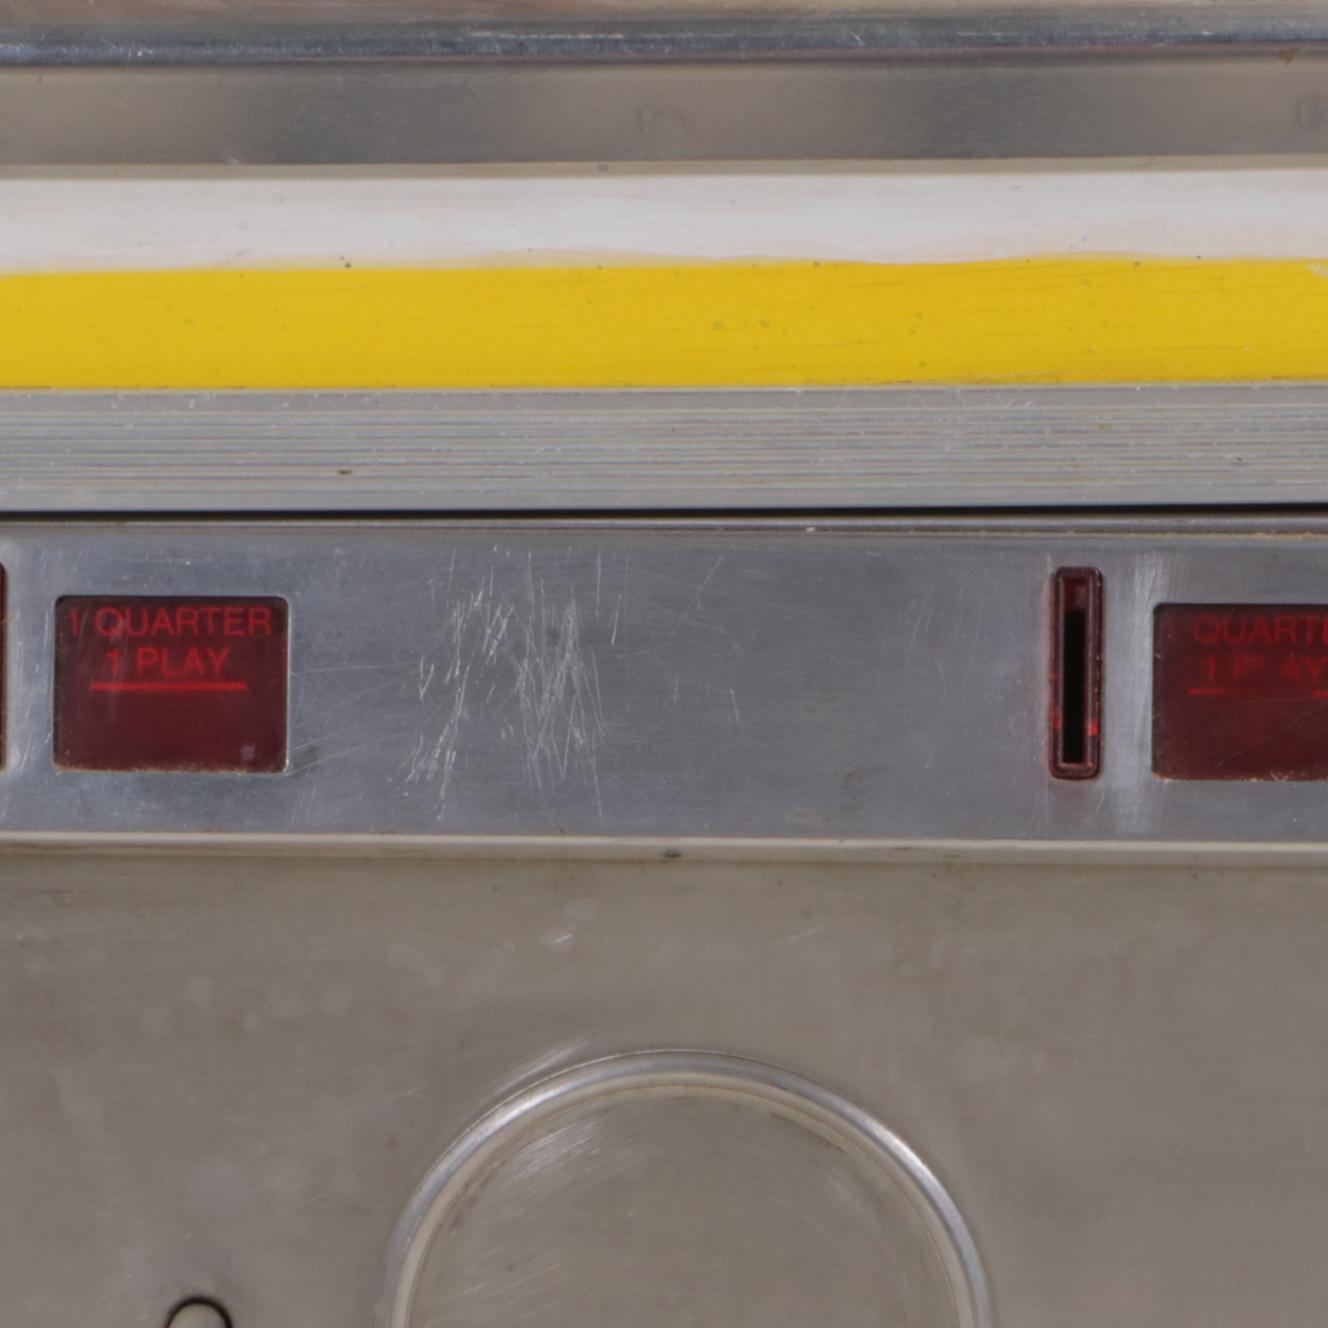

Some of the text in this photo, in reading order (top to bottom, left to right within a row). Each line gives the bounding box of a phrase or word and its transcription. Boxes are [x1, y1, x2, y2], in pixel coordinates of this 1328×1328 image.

[69, 606, 272, 637] 1 QUARTER
[106, 647, 230, 676] 1 PLAY
[1233, 652, 1328, 682] PAY
